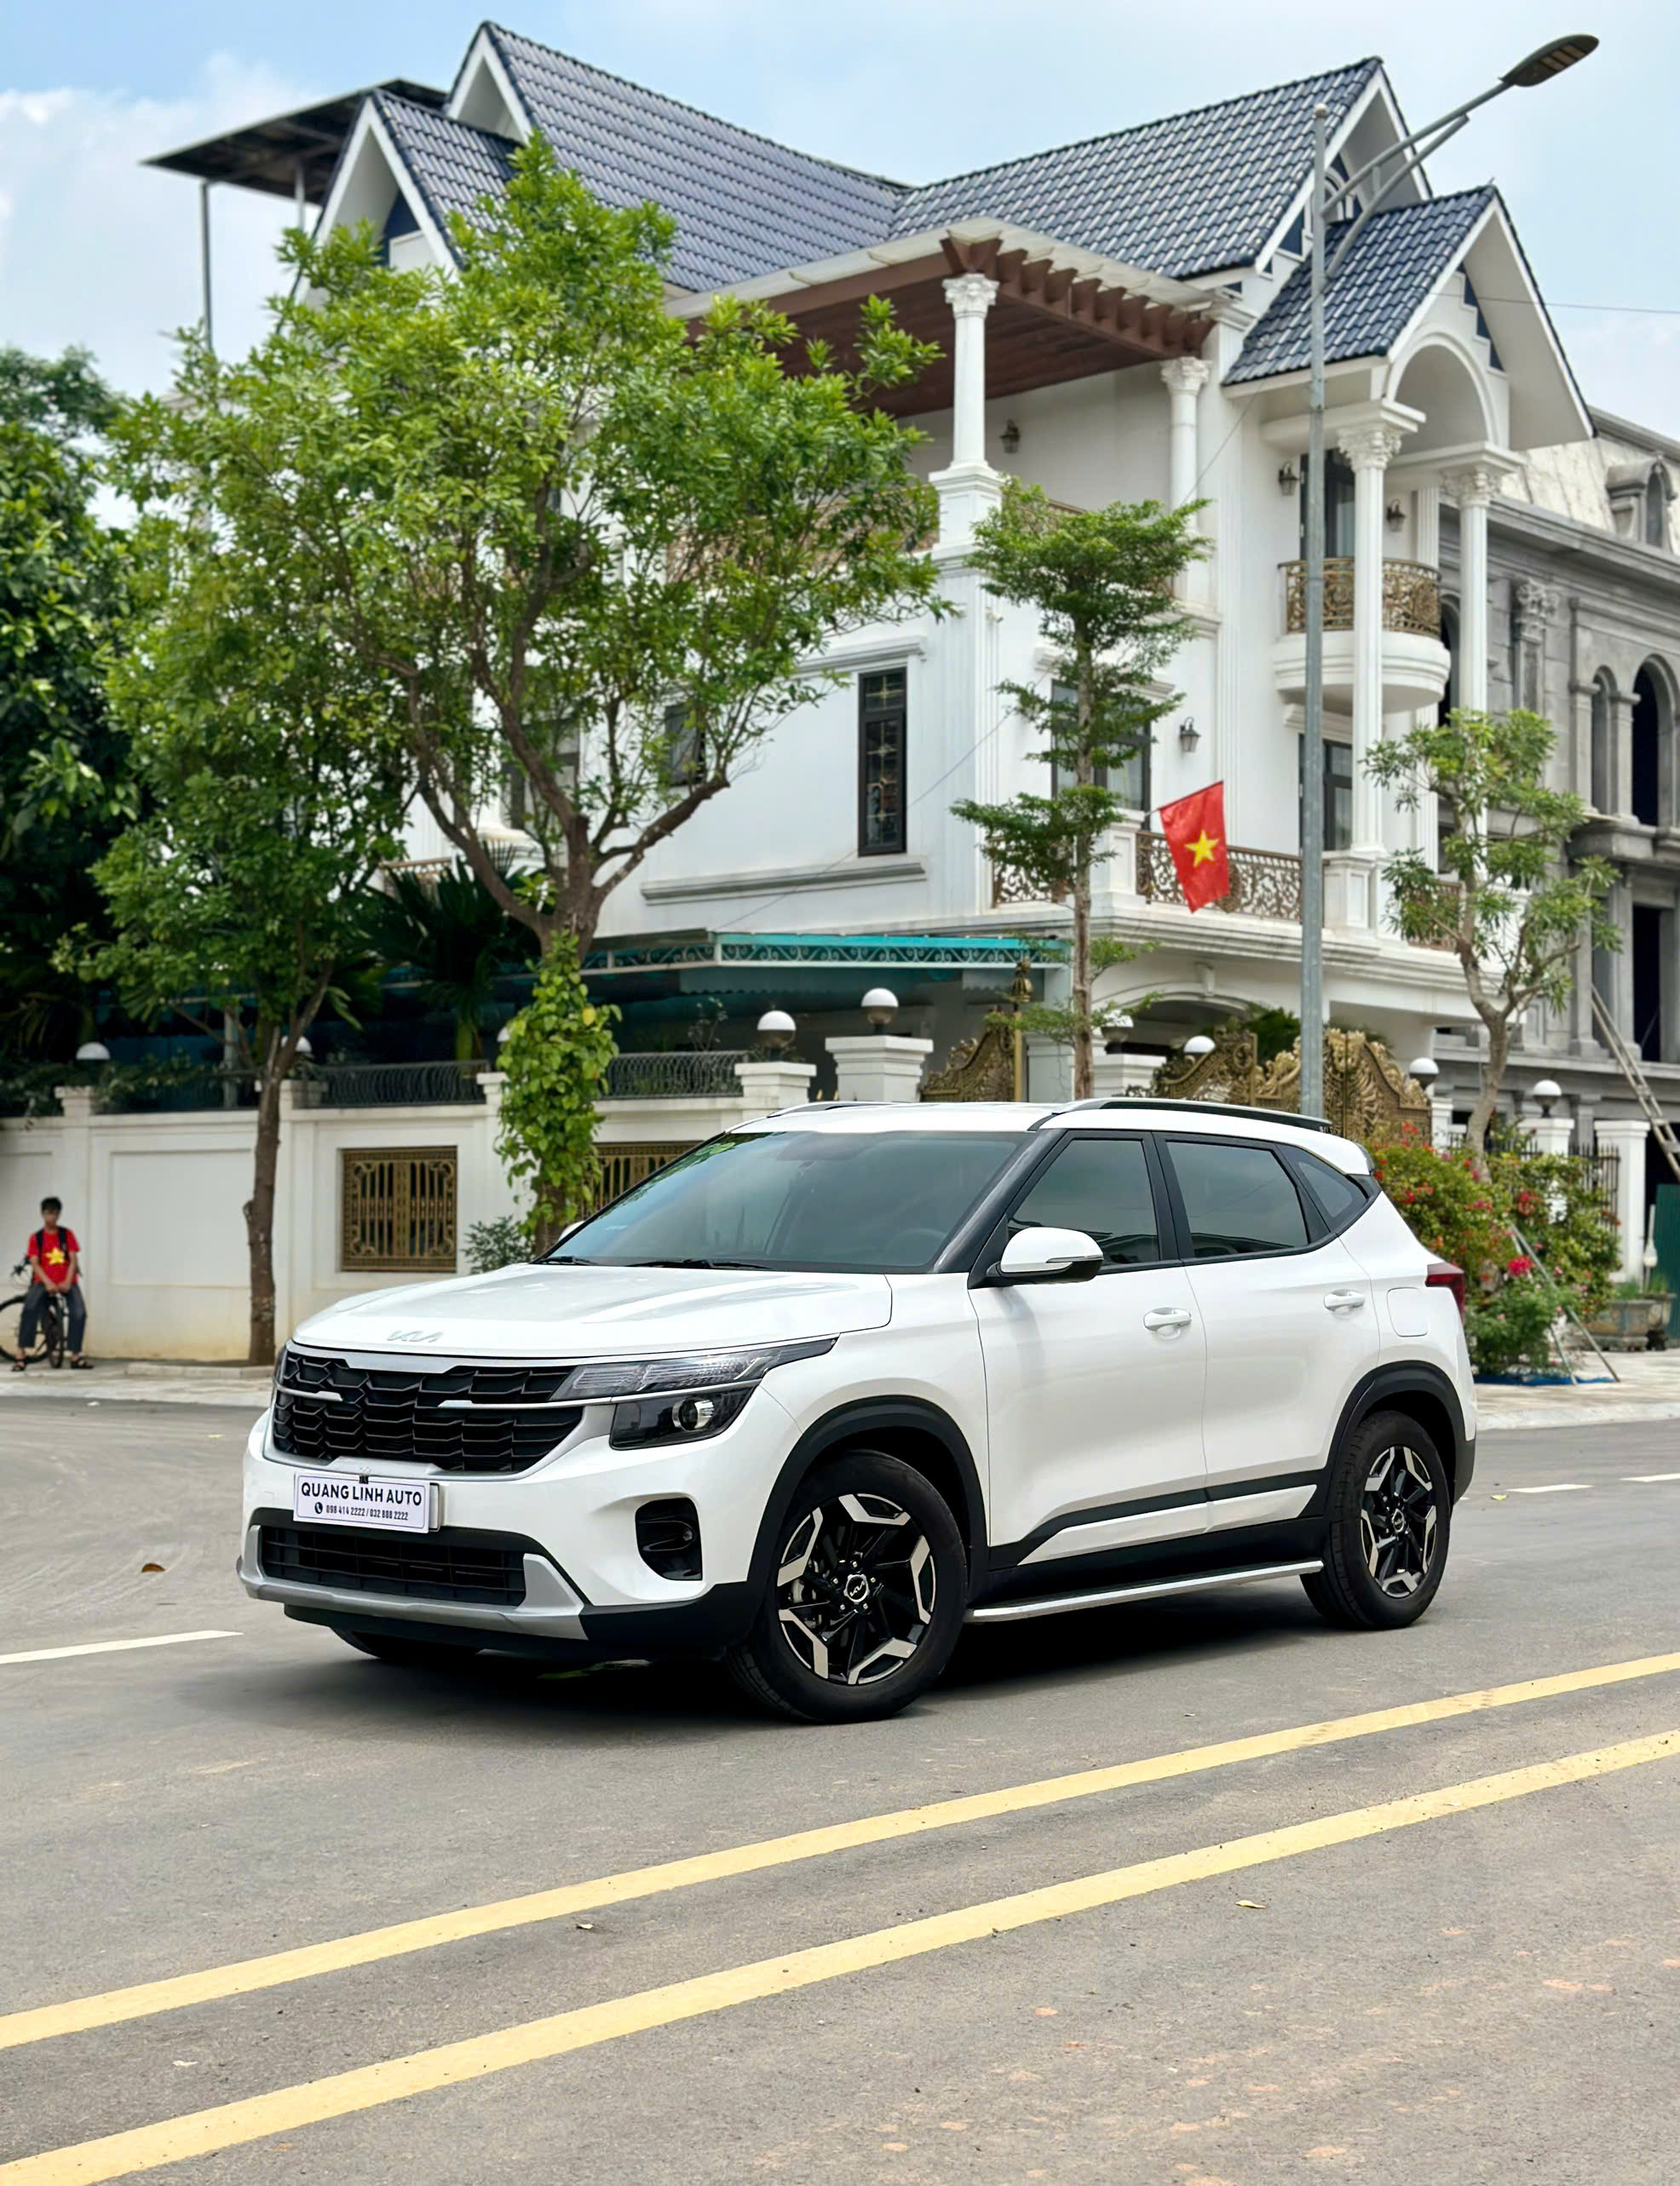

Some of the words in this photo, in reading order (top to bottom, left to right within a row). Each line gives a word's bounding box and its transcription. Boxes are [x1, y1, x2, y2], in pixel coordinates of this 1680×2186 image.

[302, 1482, 349, 1499] QUANG
[353, 1486, 383, 1502] LINH
[386, 1489, 422, 1506] AUTO
[326, 1504, 337, 1514] 098
[338, 1506, 349, 1515] 414
[350, 1507, 365, 1516] 2222
[370, 1509, 381, 1518] 032
[394, 1511, 409, 1521] 2222
